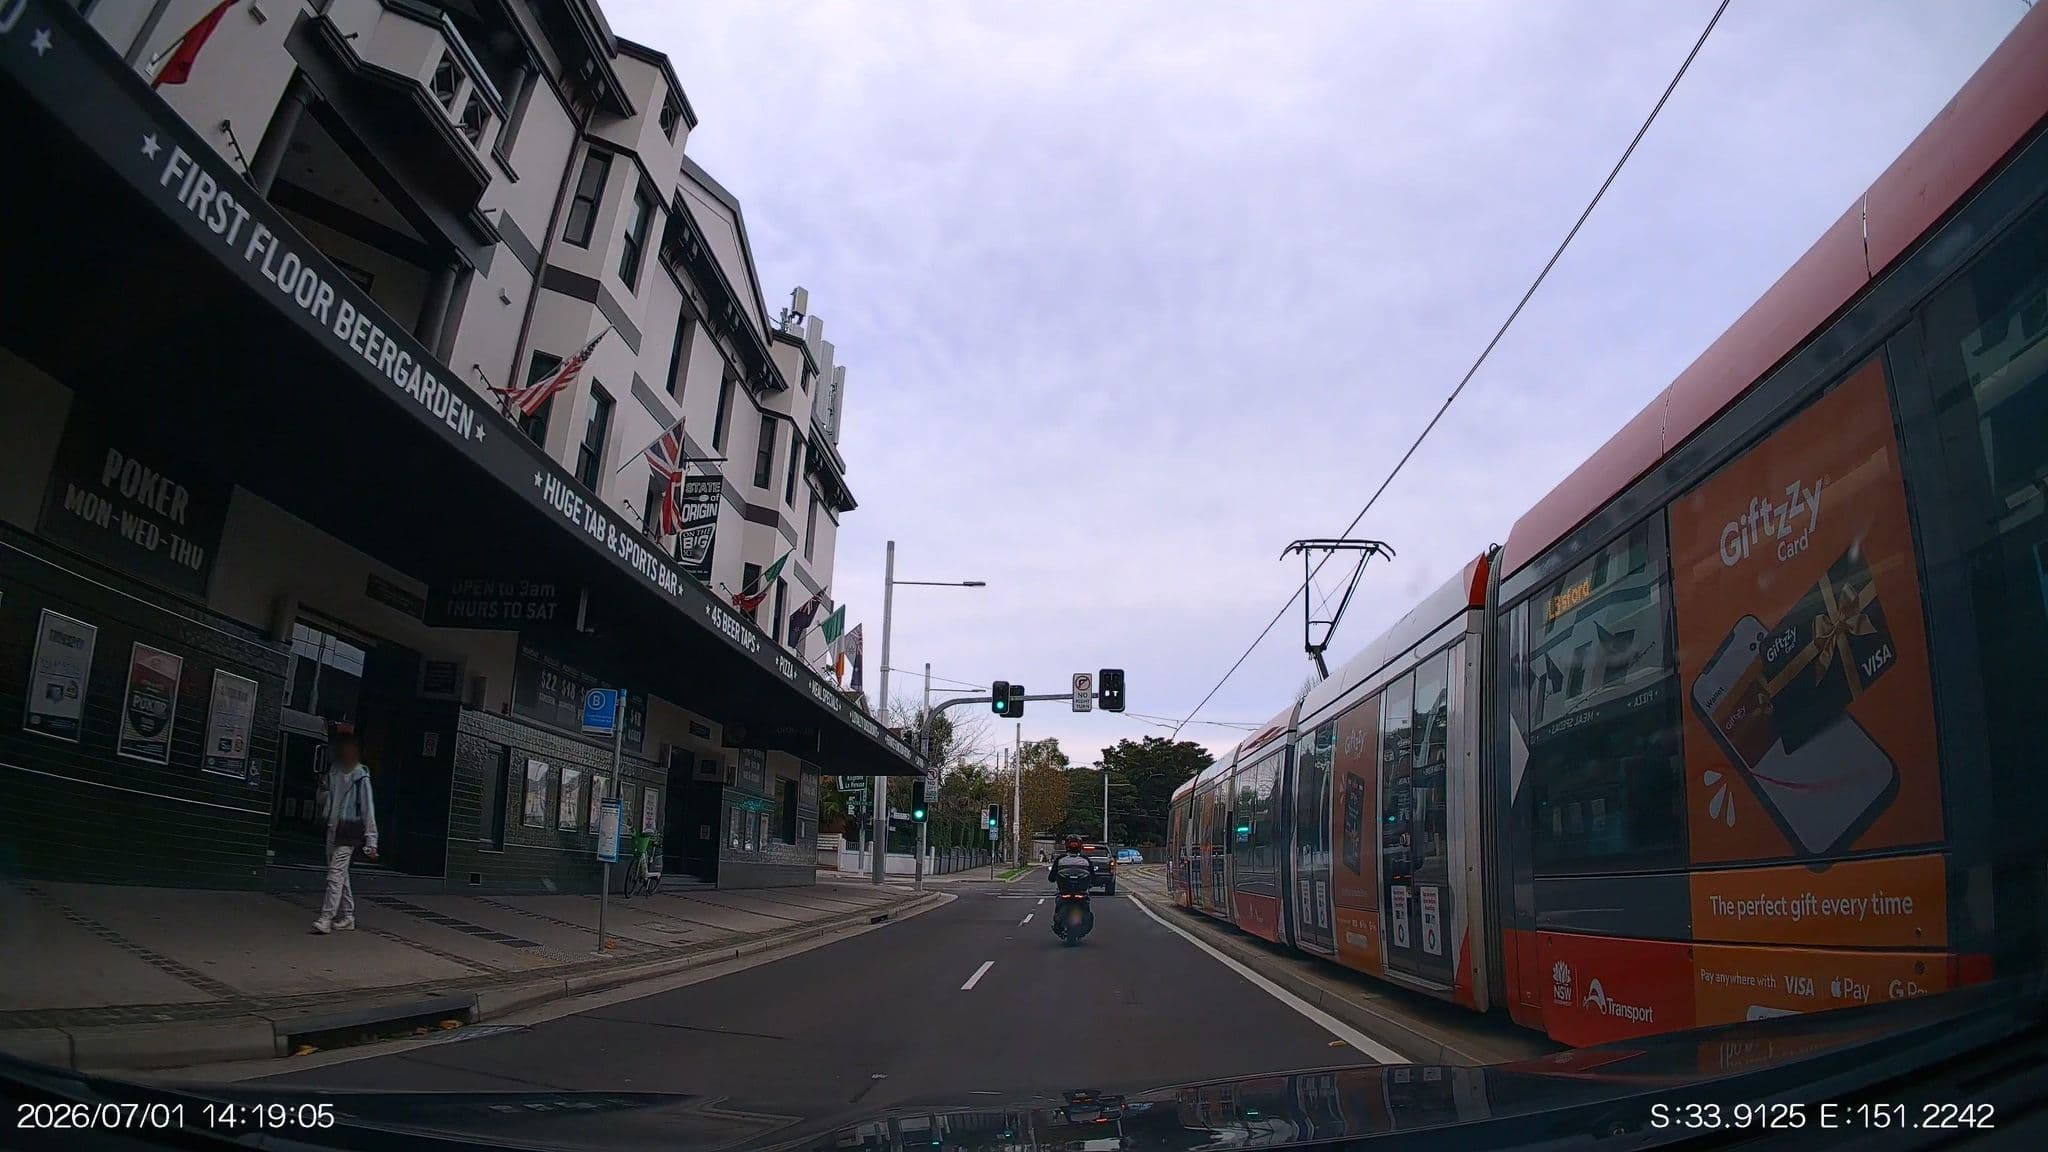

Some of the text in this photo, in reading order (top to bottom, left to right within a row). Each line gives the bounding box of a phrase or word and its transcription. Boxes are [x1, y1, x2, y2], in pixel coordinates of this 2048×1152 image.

[160, 145, 476, 441] FIRST FLOOR BEERGARDEN
[102, 447, 189, 526] POKER
[685, 482, 721, 494] STATE
[710, 493, 721, 502] of
[682, 503, 718, 523] ORIGIN
[543, 473, 678, 597] HUGE TAB & SPORTS BAR
[683, 534, 709, 549] BIG
[696, 527, 712, 536] THE
[1777, 528, 1809, 562] Card
[450, 580, 495, 596] OPEN
[519, 580, 556, 598] 3am
[448, 600, 559, 621] THURS TO SAT
[711, 605, 757, 654] 45 BEER TAPS
[779, 655, 795, 681] PIZZA
[1861, 644, 1892, 677] VISA
[541, 669, 558, 692] $22
[592, 695, 601, 707] B
[1705, 686, 1725, 710] Wallet
[1710, 890, 1914, 922] The perfect gift every time
[1700, 968, 1777, 989] Pay anywhere with
[1784, 975, 1815, 998] VISA
[1553, 985, 1572, 1001] NSW
[1844, 978, 1871, 1004] Pay
[1607, 997, 1654, 1024] Transport
